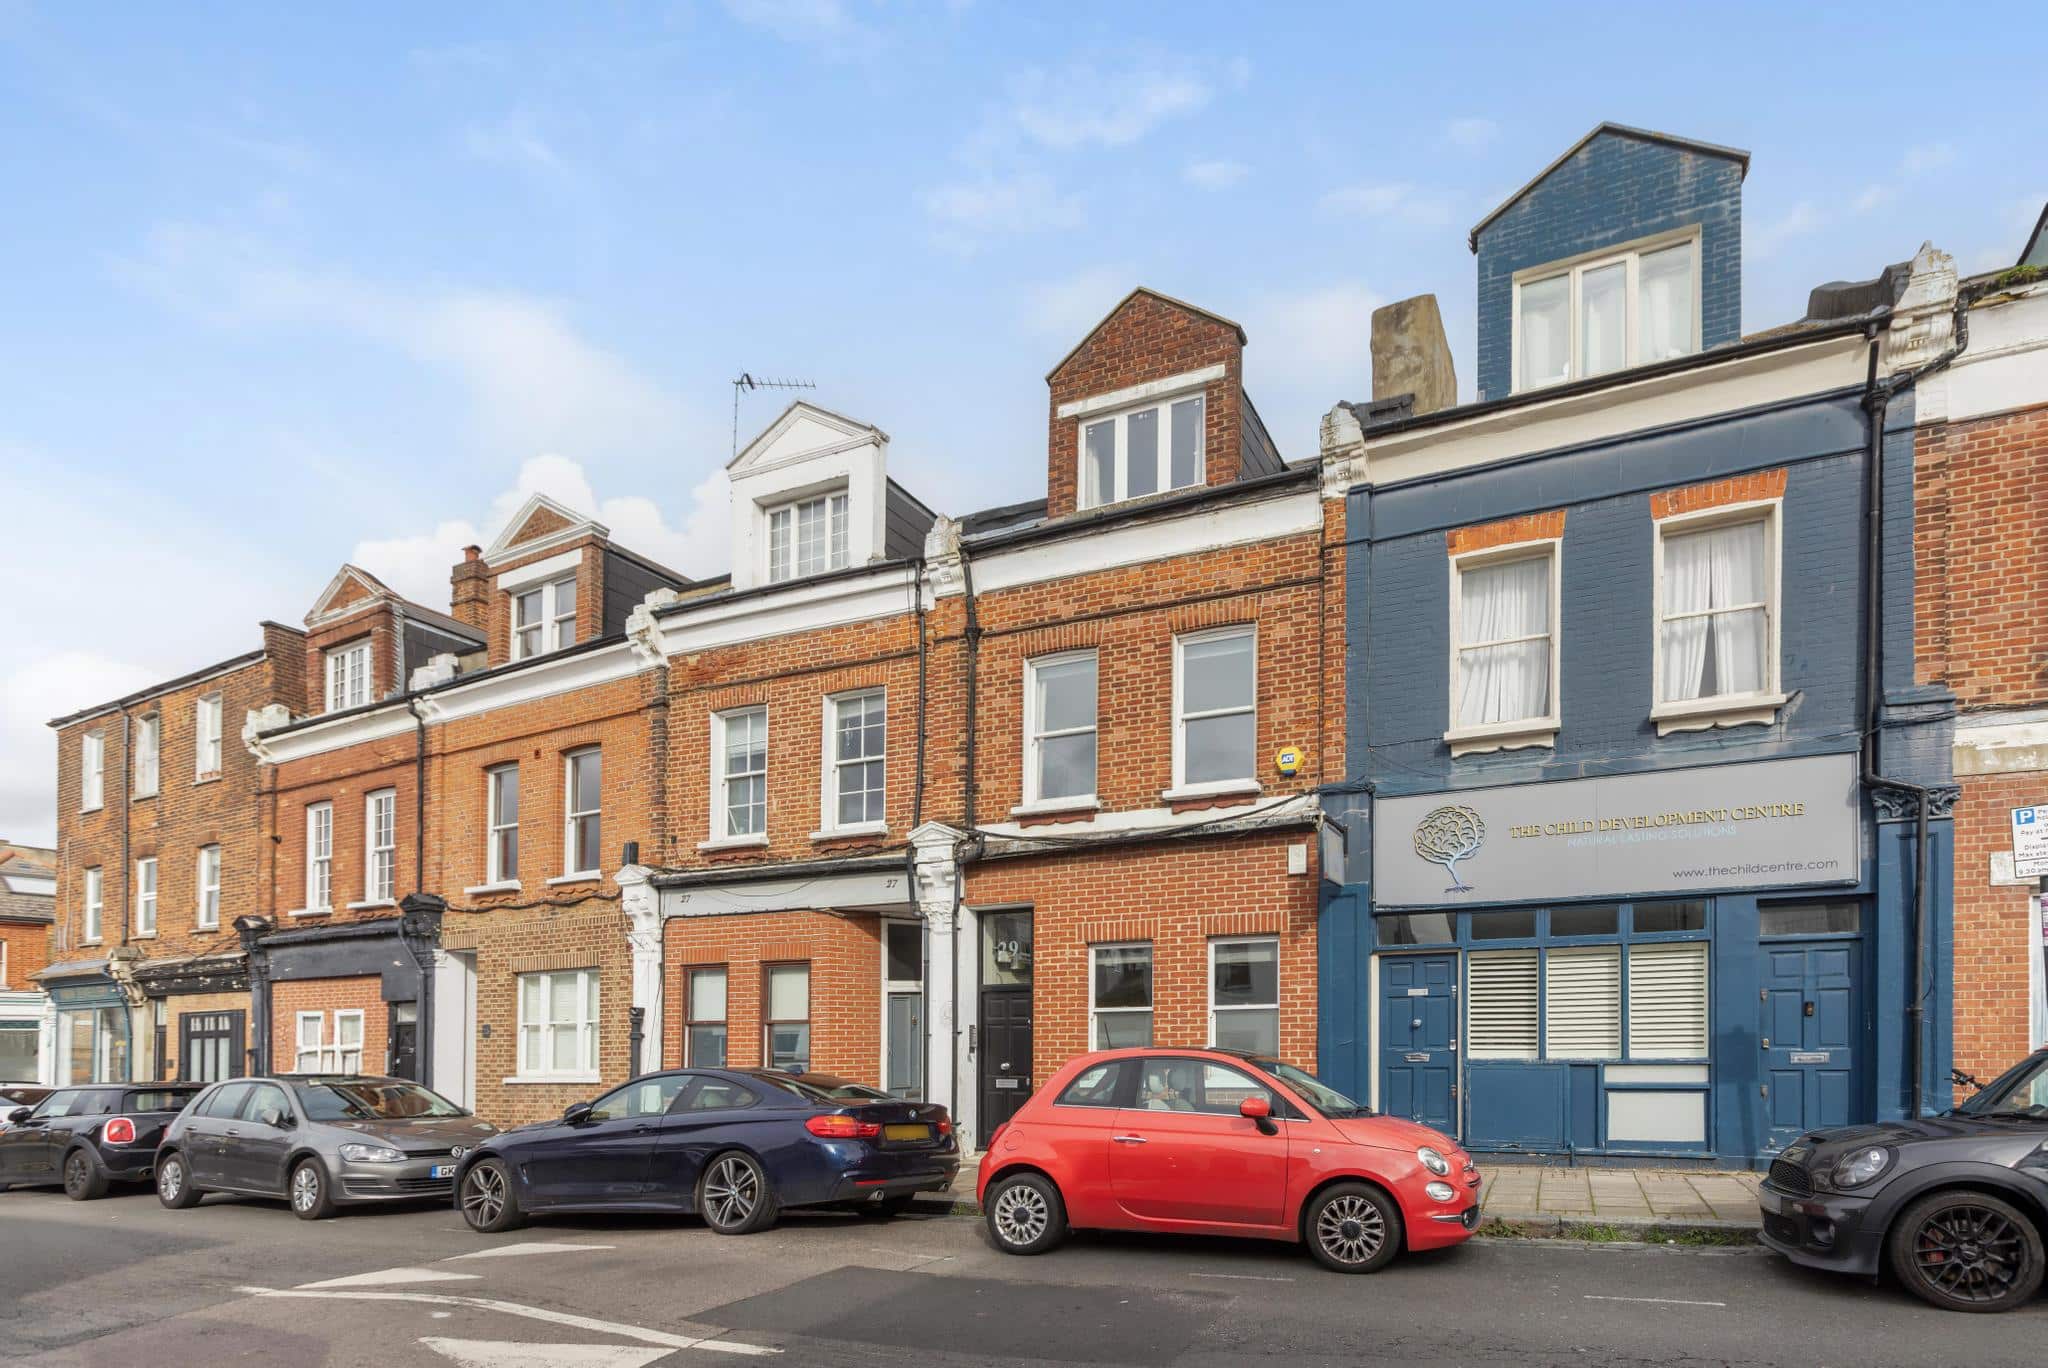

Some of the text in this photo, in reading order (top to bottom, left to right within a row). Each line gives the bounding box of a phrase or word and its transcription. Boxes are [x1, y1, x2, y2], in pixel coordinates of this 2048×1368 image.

[1510, 802, 1805, 838] THE CHILD DEVELOPMENT CENTRE
[1672, 859, 1839, 878] www.thechildcentre.com
